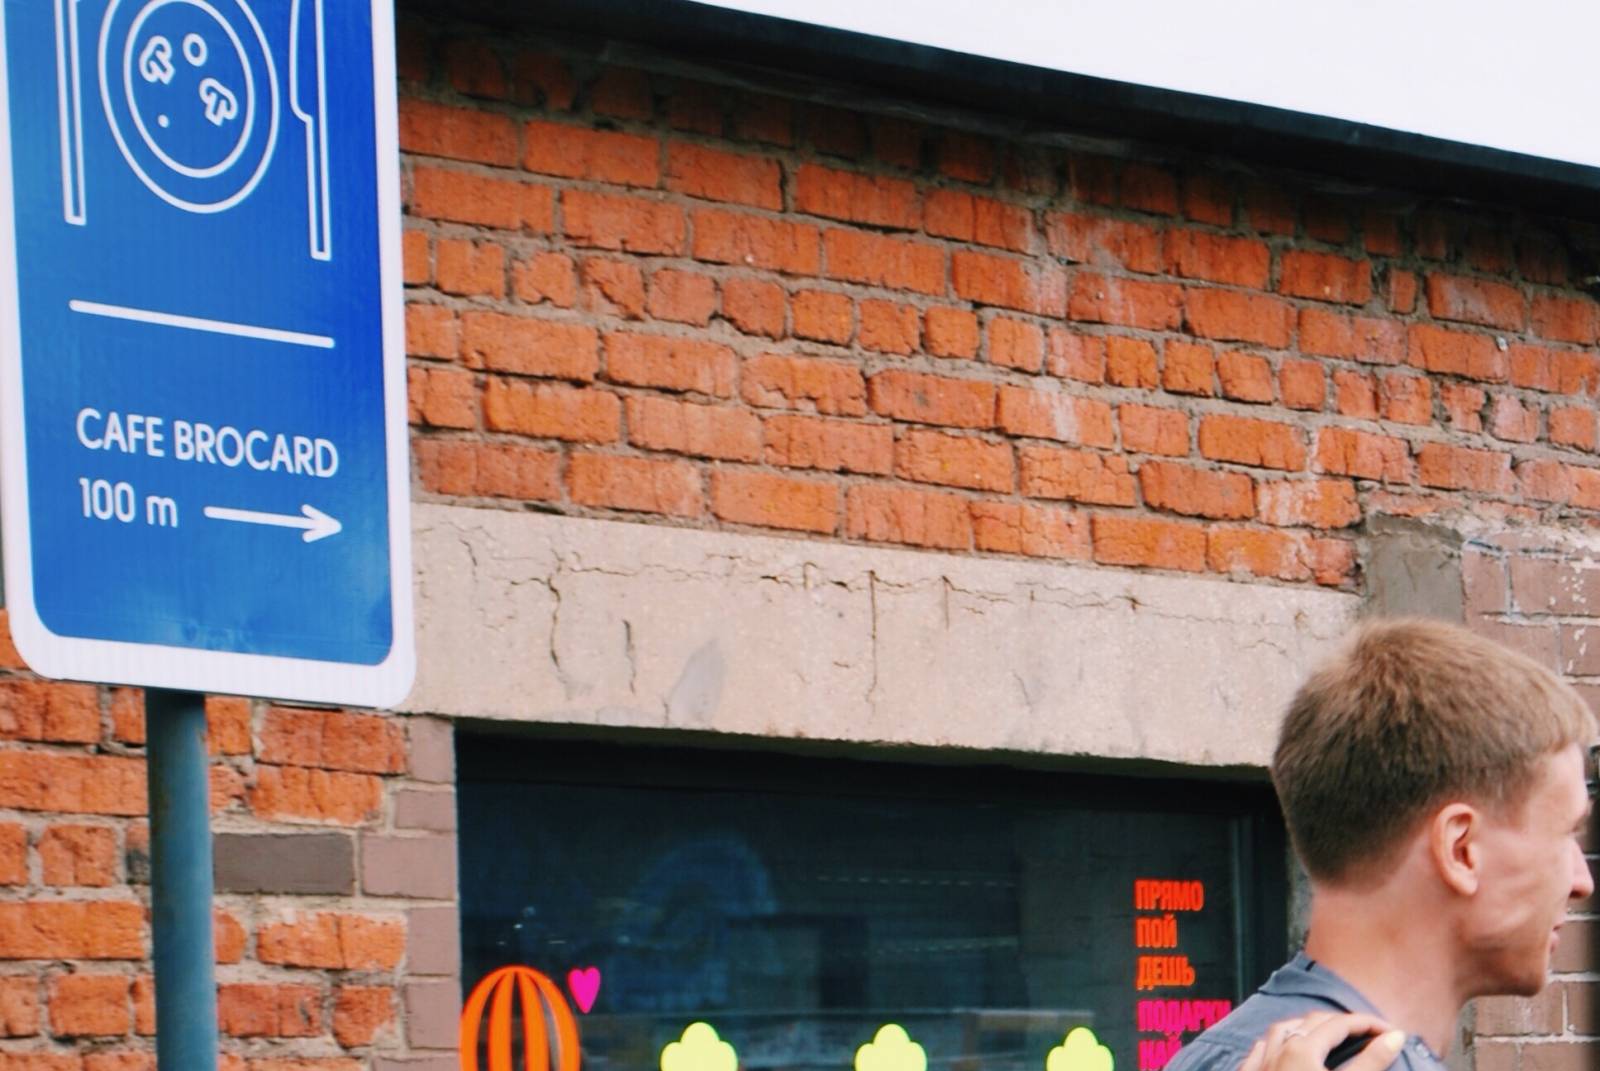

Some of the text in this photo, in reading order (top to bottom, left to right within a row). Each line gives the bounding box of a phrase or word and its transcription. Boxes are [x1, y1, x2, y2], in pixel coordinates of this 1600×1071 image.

[76, 408, 339, 479] CAFE BROCARD
[79, 478, 178, 527] 100 m
[1135, 880, 1204, 911] ПРЯМО
[1135, 914, 1177, 948] ПОЙ
[1136, 955, 1195, 990] ДЕШЬ
